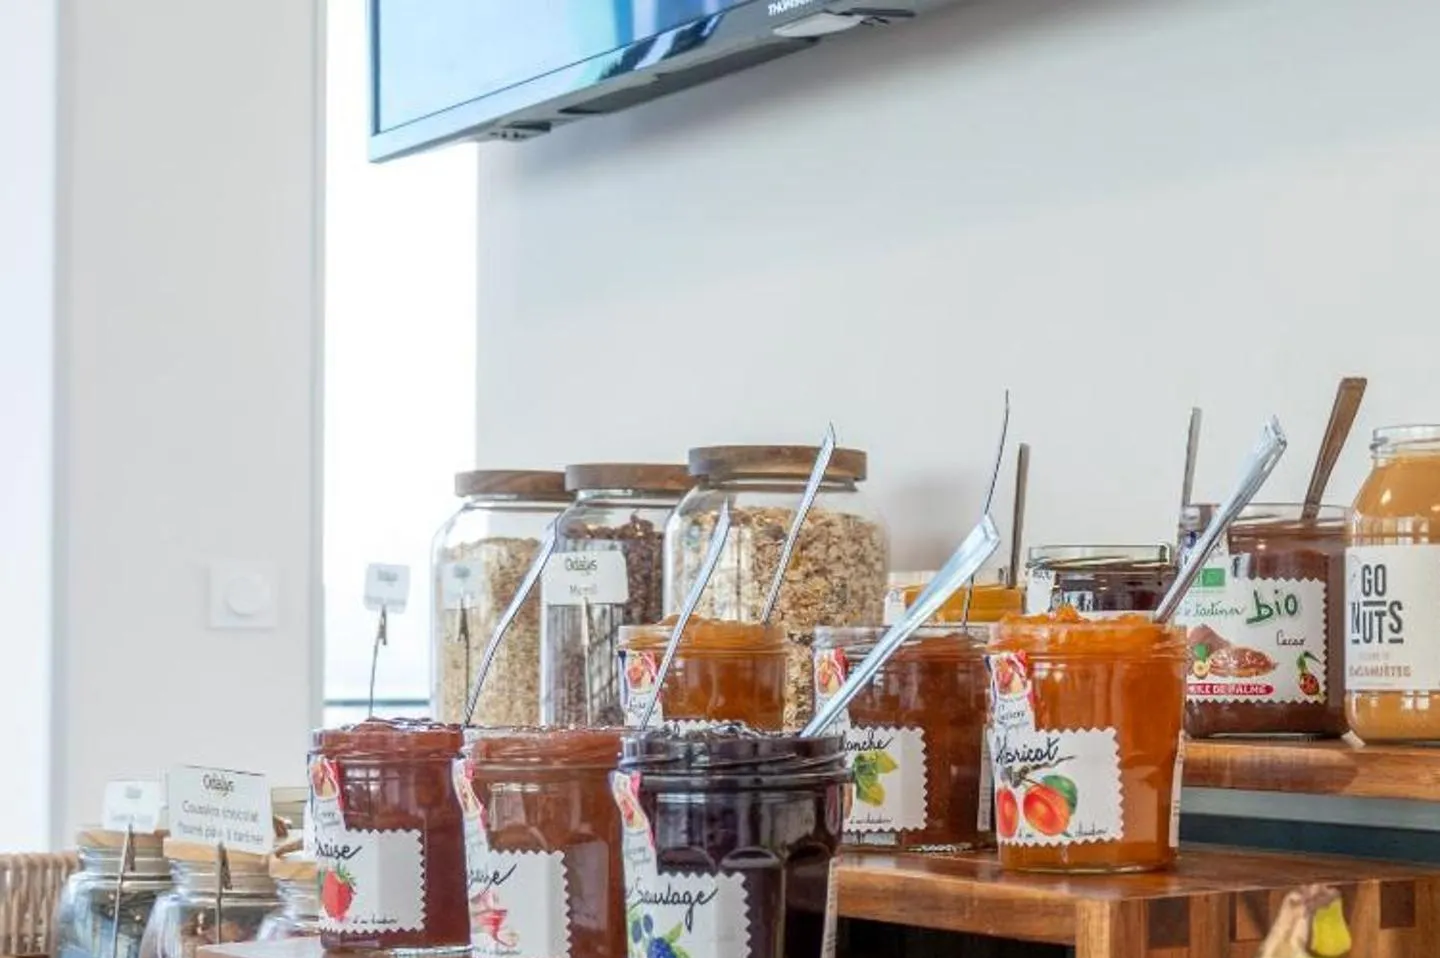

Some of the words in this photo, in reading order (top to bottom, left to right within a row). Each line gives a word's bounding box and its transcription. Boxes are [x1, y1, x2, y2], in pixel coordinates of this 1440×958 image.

[1361, 563, 1387, 597] GO
[1246, 589, 1298, 624] bio
[1351, 599, 1403, 644] NUTS
